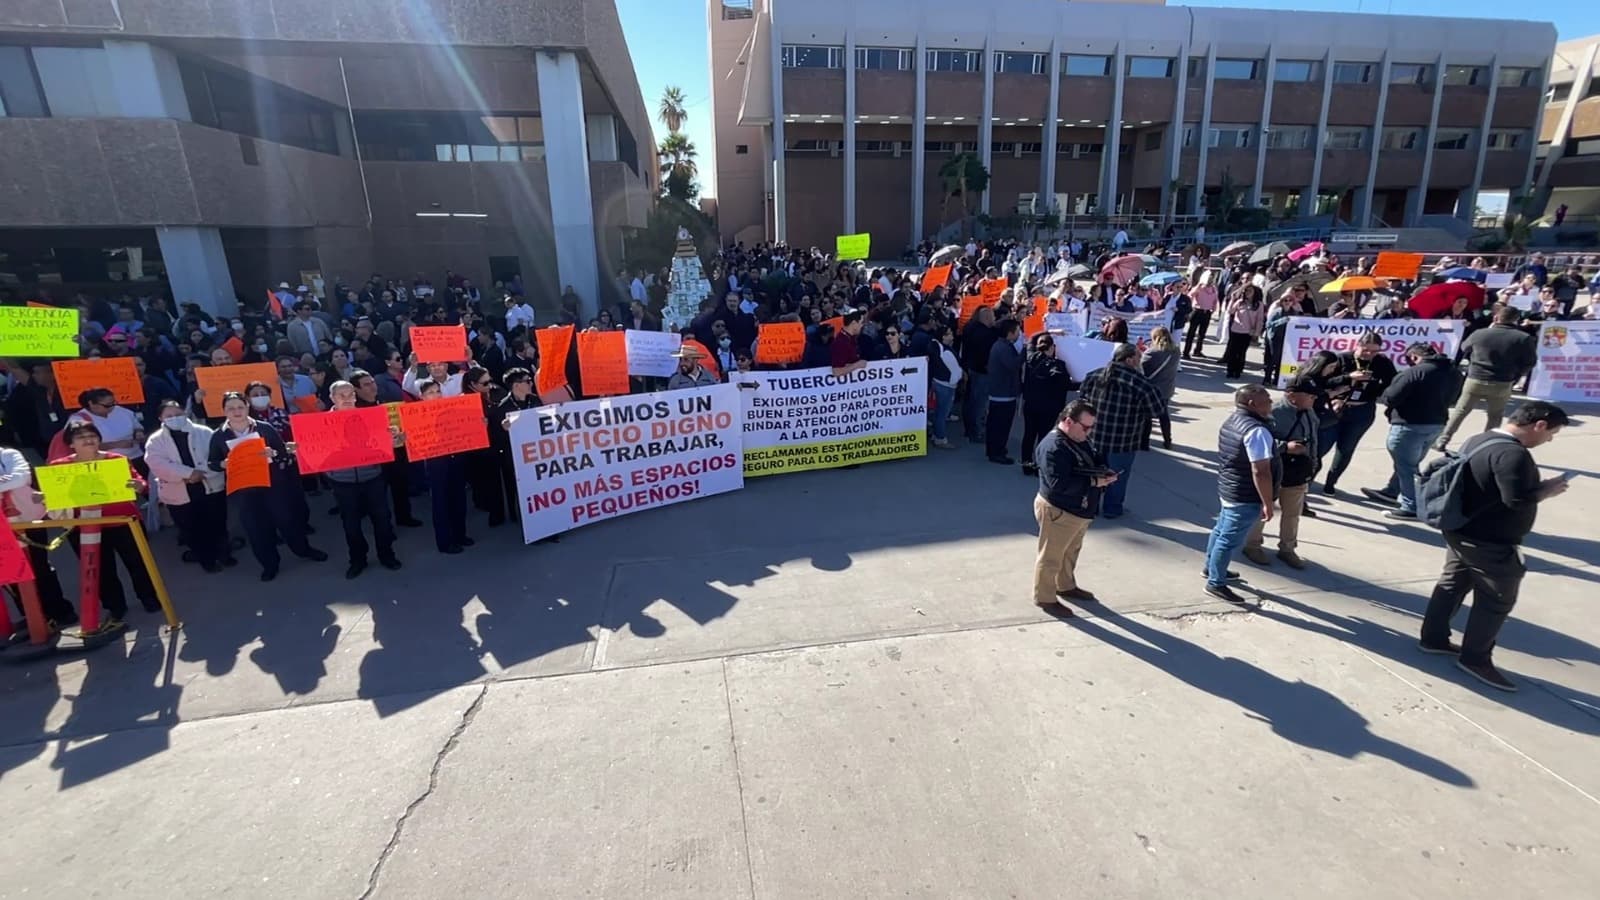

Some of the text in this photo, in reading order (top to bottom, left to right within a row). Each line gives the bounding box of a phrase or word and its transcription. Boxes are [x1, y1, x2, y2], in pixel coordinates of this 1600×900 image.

[1318, 323, 1429, 336] VACUNACIÓN
[1298, 336, 1406, 353] EXIGIOS
[767, 367, 894, 391] TUBERCULOSIS
[747, 395, 913, 420] BUEN ESTADO PARA PODER
[753, 384, 907, 408] EXIGIMOS VEHÍCULOS EN
[539, 395, 712, 435] EXIGIMOS UN
[743, 405, 925, 432] RINDAR ATENCIÓN OPORTUNA
[521, 425, 641, 464] EDIFICIO
[652, 412, 732, 439] DIGNO
[779, 421, 884, 441] A LA POBLACIÓN.
[535, 433, 724, 480] PARA TRABAJAR,
[744, 434, 917, 461] RECLAMAMOS ESTACIONAMIENTO
[788, 455, 815, 467] PARA
[818, 453, 839, 464] LOS
[843, 442, 920, 460] TRABAJADORES
[527, 453, 736, 514] ¡NO MÁS ESPACIOS
[572, 480, 701, 523] PEQUEÑOS!
